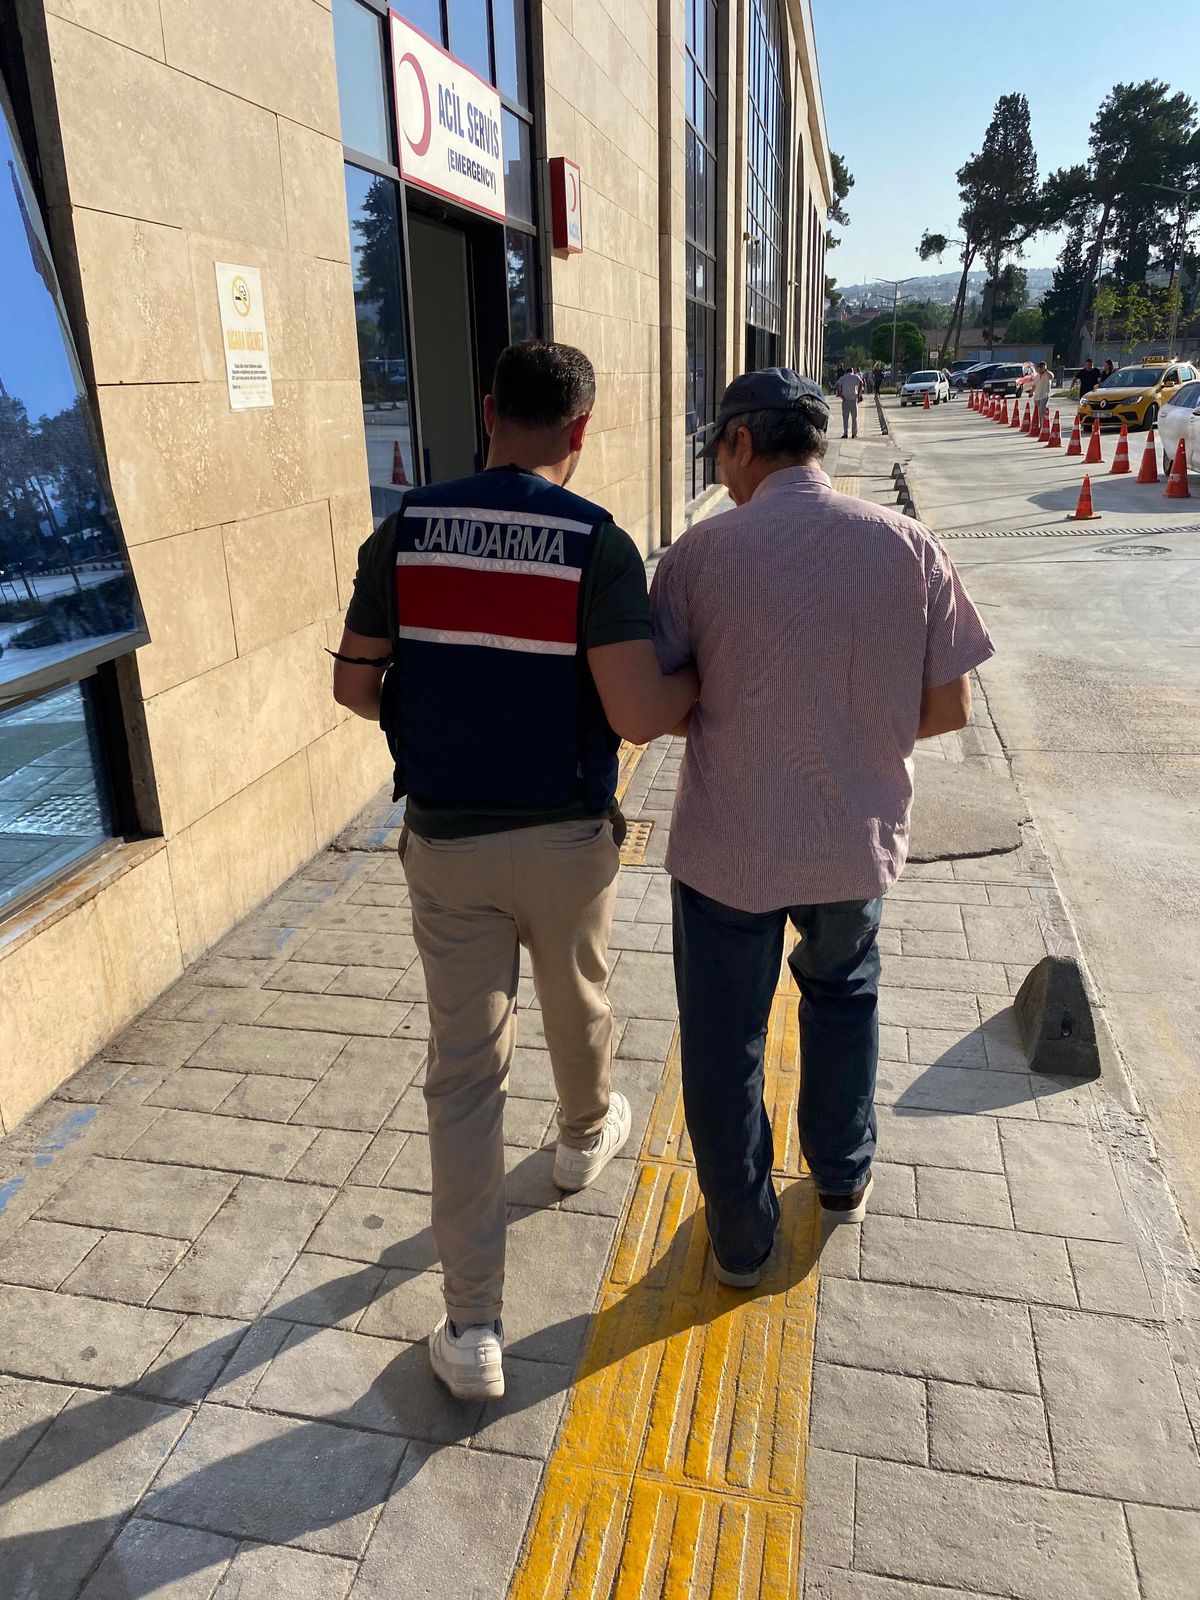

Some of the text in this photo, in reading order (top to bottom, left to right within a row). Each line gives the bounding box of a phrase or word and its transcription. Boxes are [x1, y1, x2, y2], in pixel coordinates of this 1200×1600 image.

[438, 82, 500, 160] ACİL SERVİS
[447, 147, 497, 195] (EMERGENCY)
[414, 517, 565, 564] JANDARMA
